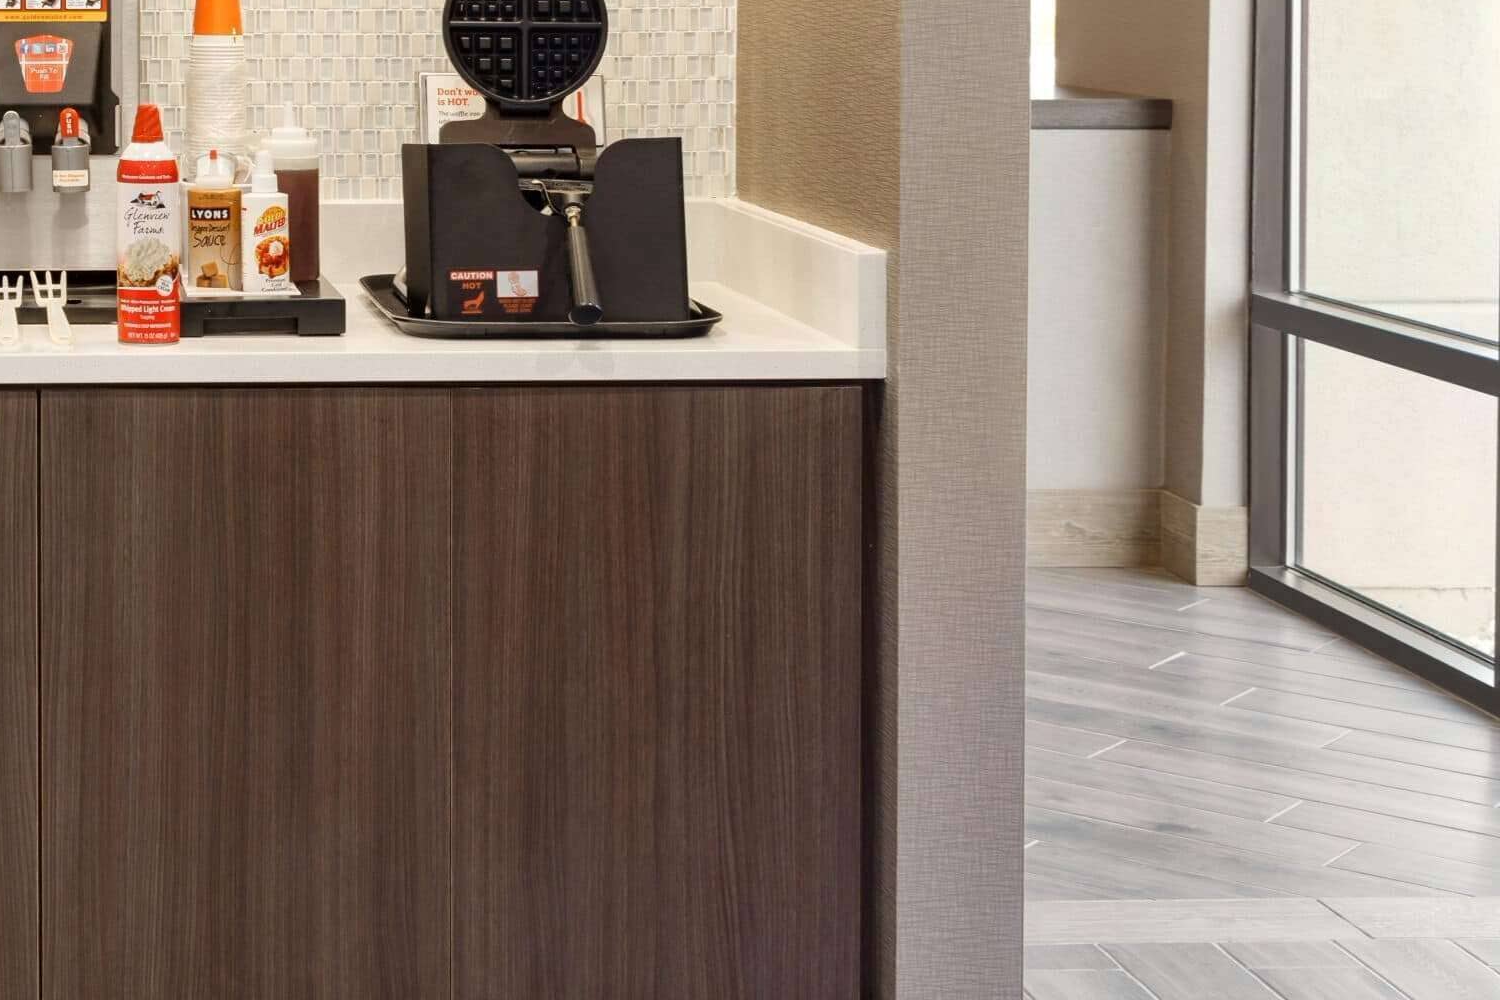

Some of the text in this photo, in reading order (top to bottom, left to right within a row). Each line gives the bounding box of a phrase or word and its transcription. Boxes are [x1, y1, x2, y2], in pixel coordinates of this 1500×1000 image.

[437, 87, 462, 96] Don't
[191, 209, 229, 219] LYONS
[193, 231, 227, 248] Sauce
[450, 271, 493, 280] CAUTION
[462, 282, 482, 290] HOT
